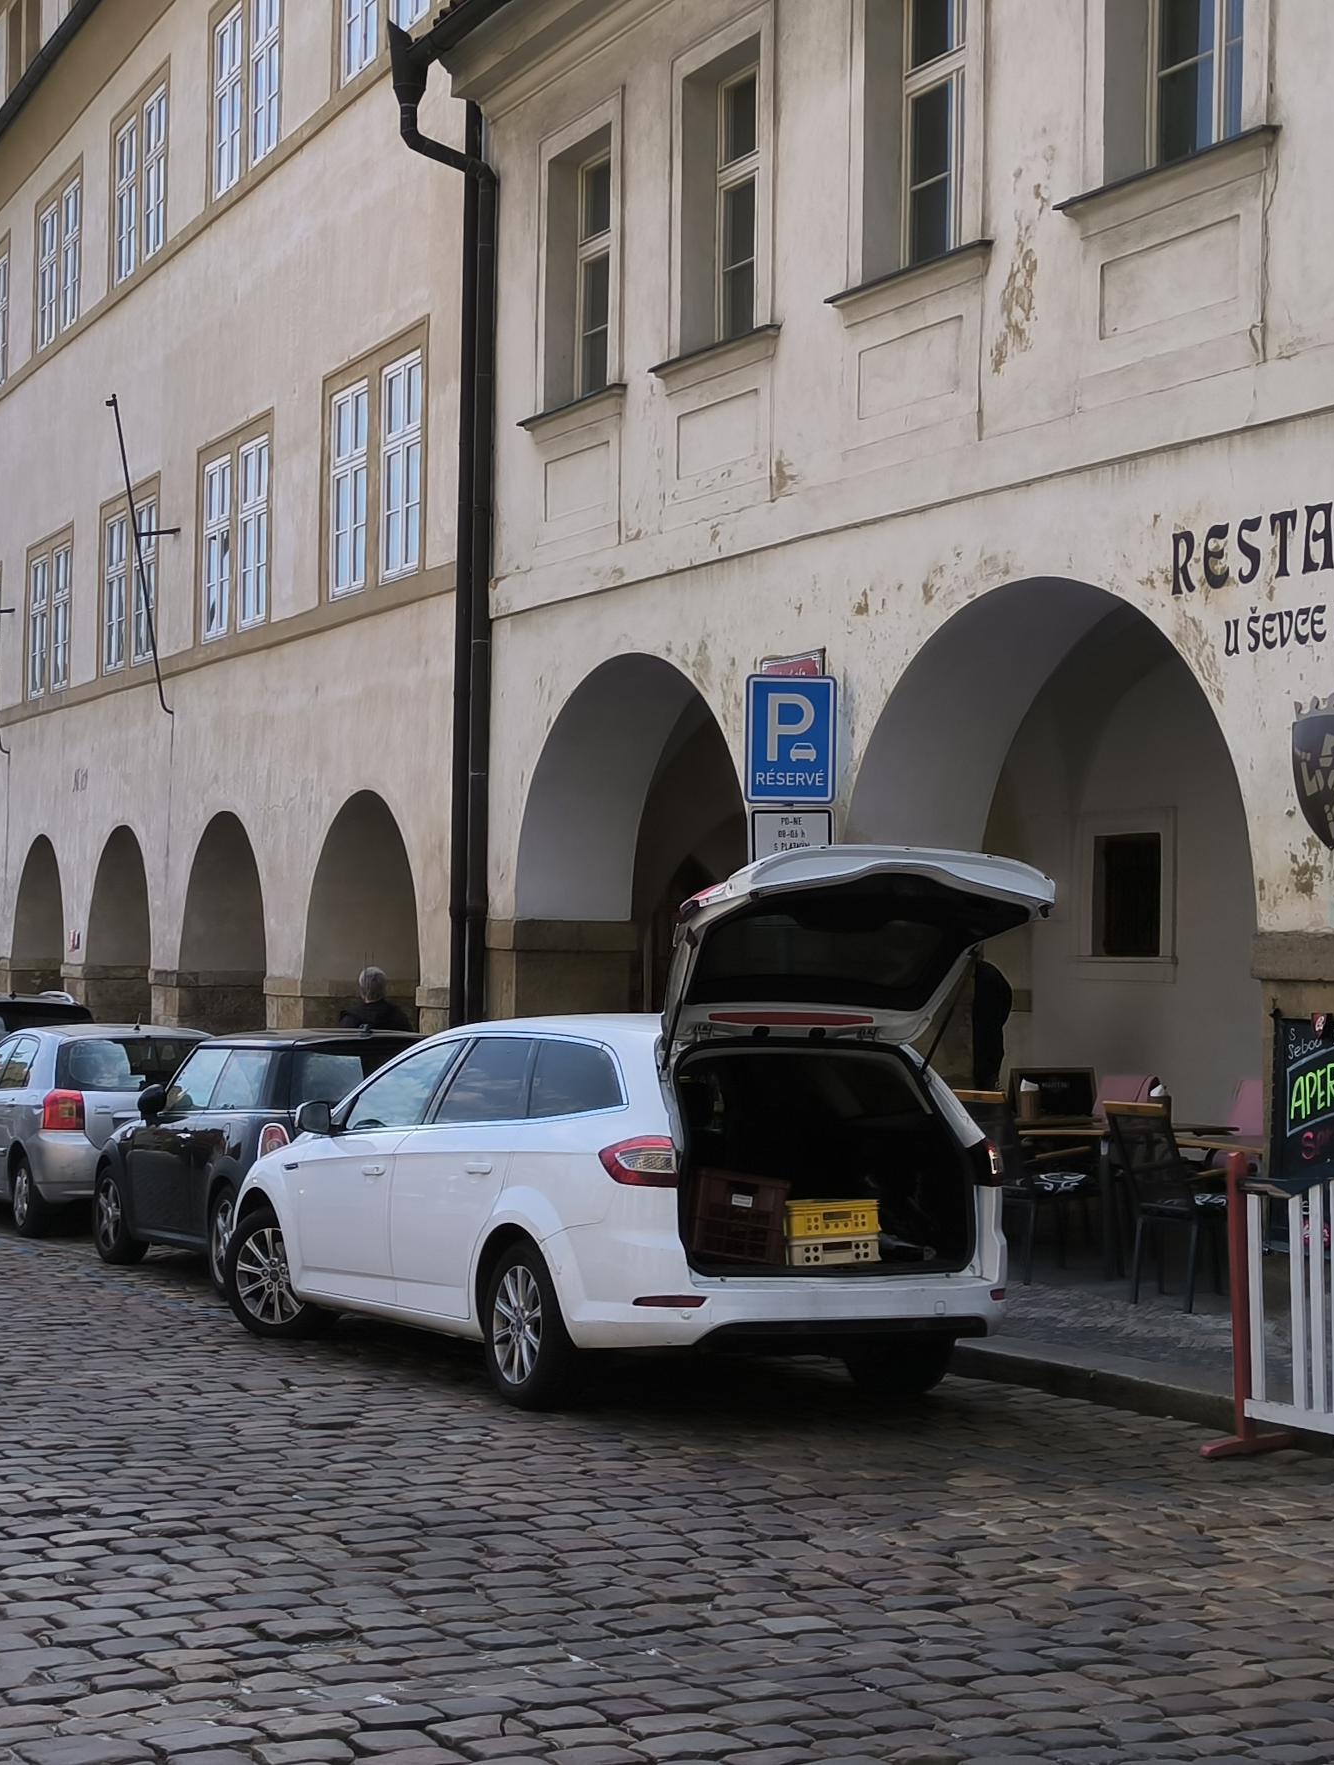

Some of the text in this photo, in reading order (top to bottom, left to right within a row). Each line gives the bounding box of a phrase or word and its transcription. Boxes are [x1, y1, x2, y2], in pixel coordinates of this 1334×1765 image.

[1223, 618, 1241, 657] U
[1247, 605, 1328, 654] ŠEVCE
[767, 692, 816, 762] P
[756, 768, 825, 786] RÉSERVÉ
